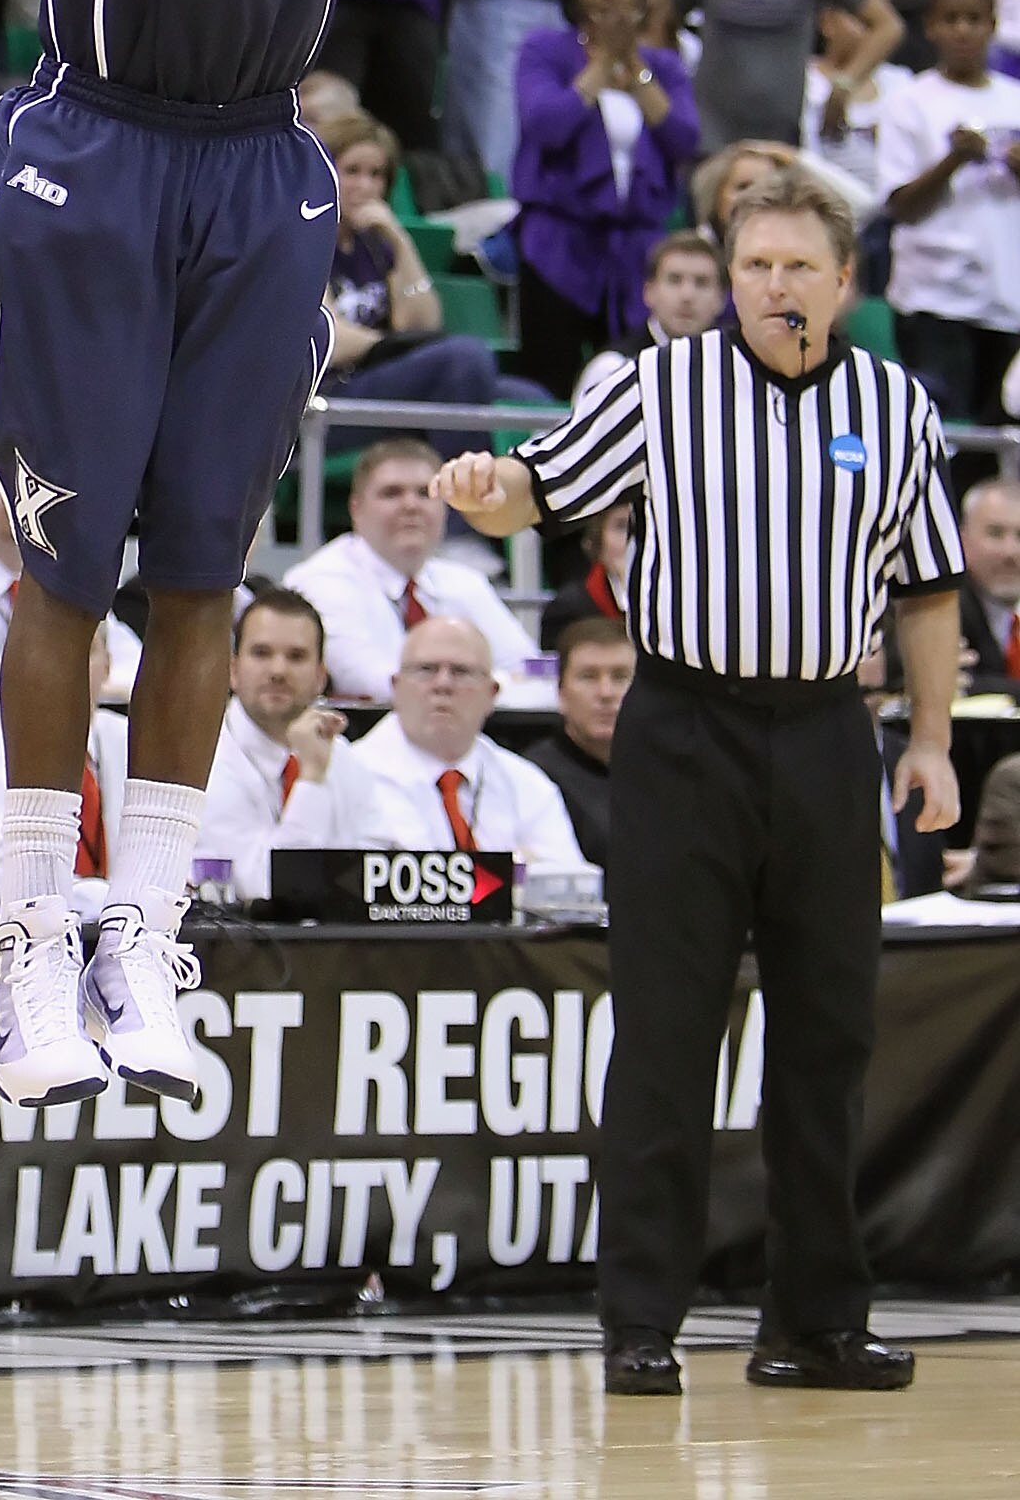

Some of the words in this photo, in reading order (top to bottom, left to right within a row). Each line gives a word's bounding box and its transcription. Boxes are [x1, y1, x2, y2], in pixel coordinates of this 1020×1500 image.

[6, 164, 68, 206] A10
[363, 852, 475, 904] POSS
[11, 1161, 226, 1277] LAKE
[248, 1156, 458, 1292] CITY,
[488, 1155, 601, 1266] UT
